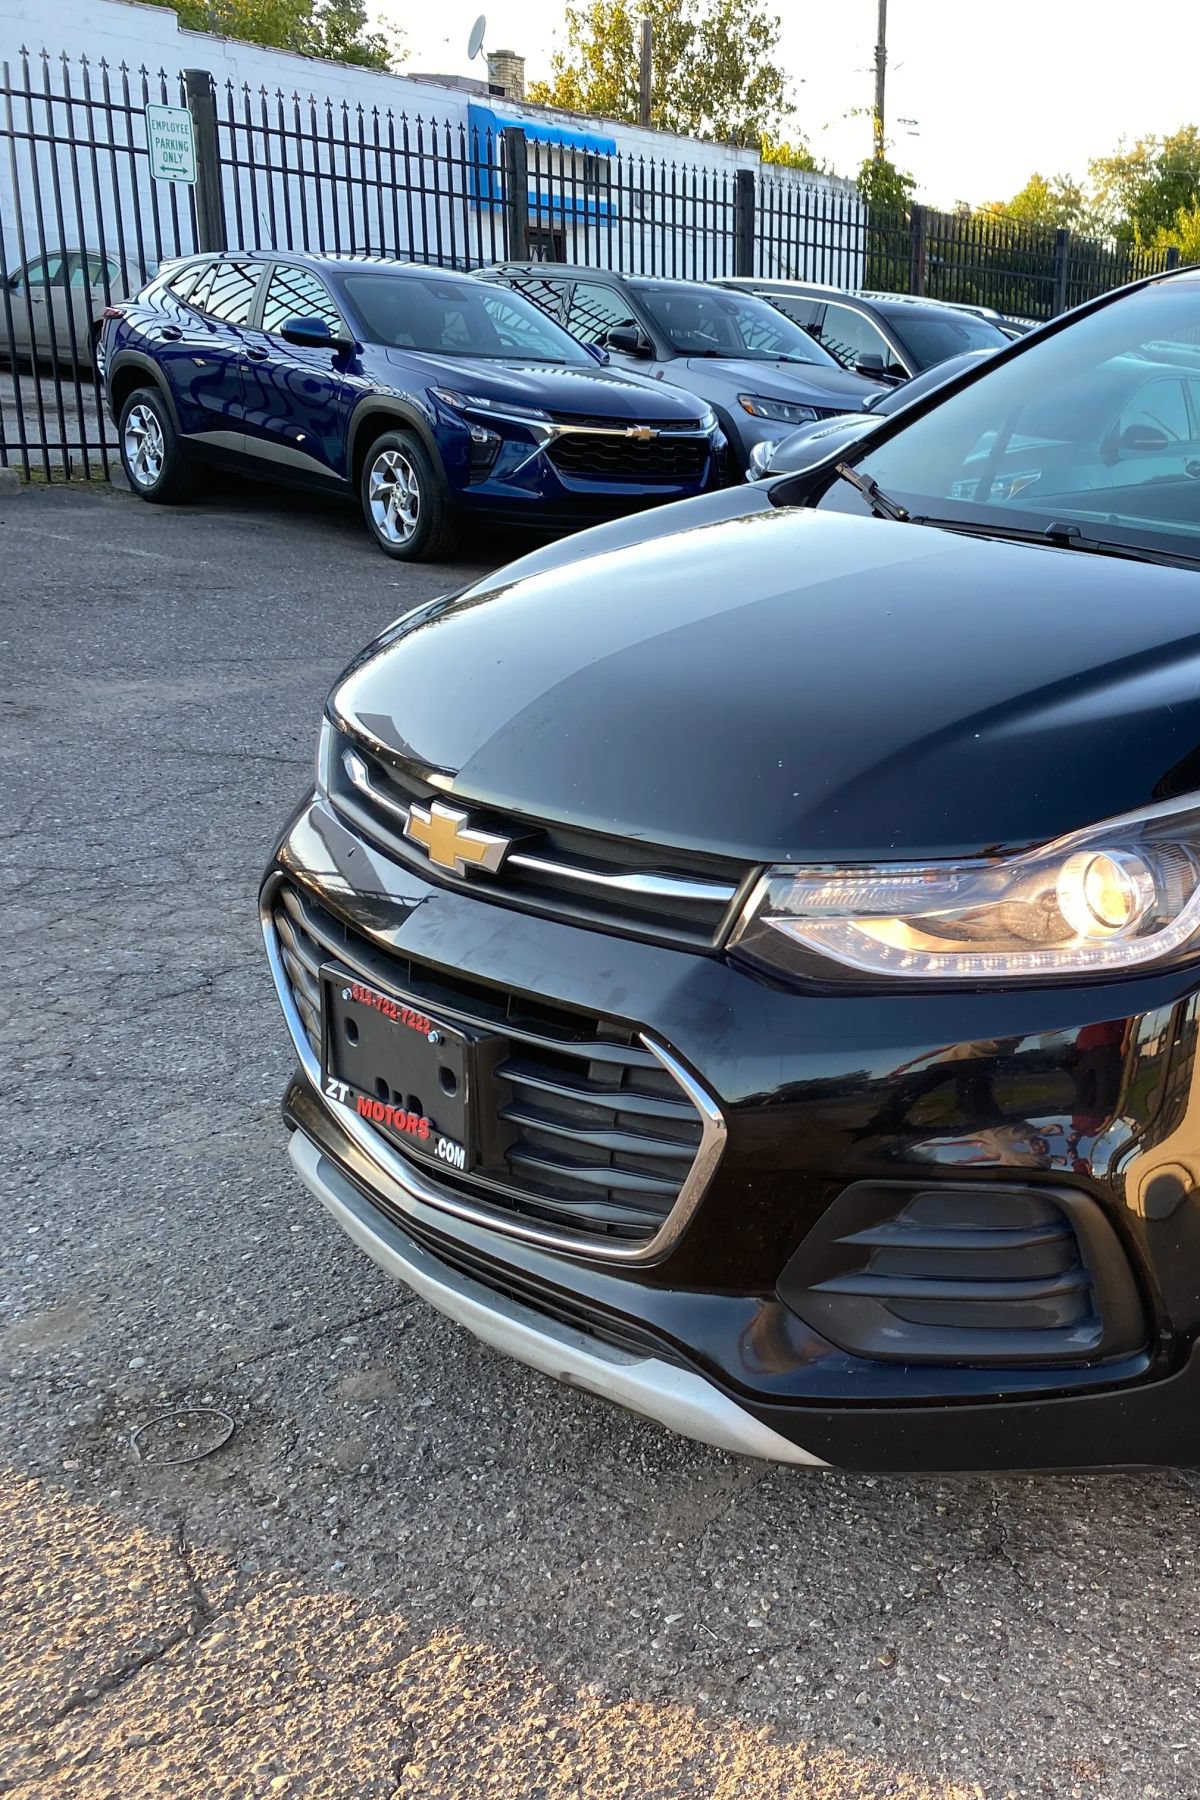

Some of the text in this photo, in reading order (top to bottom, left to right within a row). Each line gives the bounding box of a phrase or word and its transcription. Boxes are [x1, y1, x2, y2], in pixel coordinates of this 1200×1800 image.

[152, 120, 189, 134] EMPLOYEE
[156, 137, 188, 151] PARKING
[163, 152, 183, 164] ONLY
[325, 1077, 466, 1169] ZT MOTORS .COM
